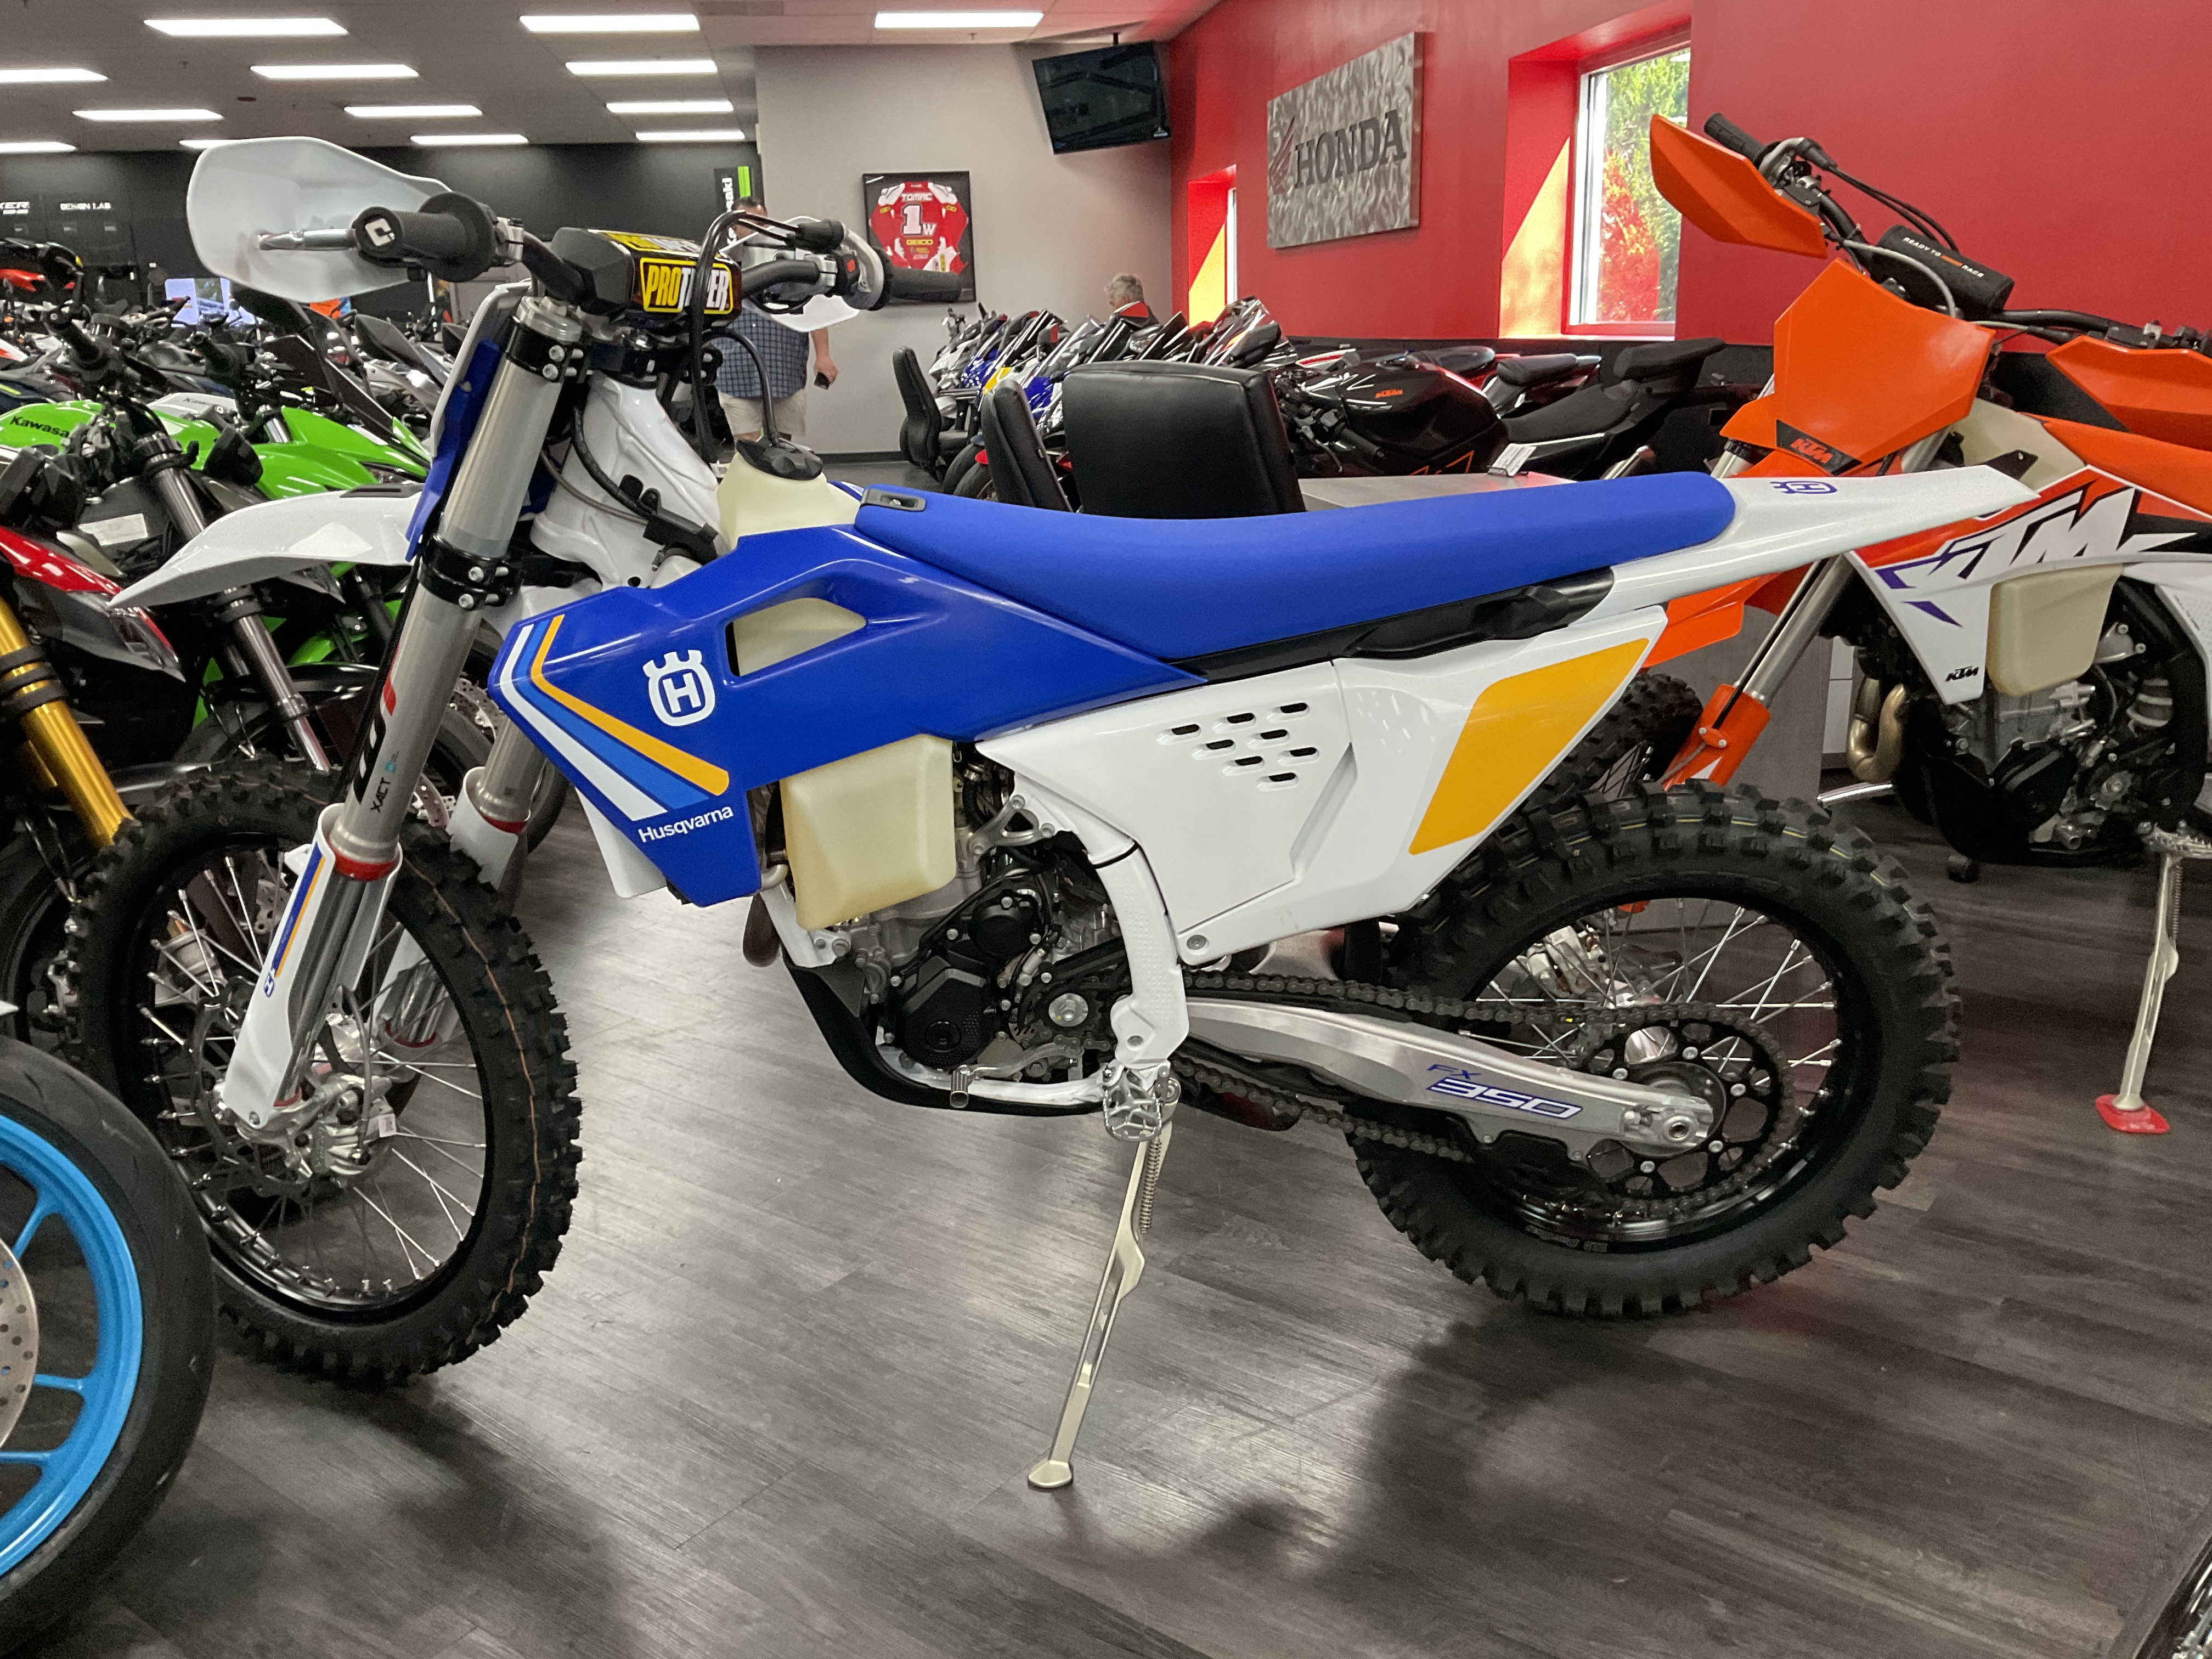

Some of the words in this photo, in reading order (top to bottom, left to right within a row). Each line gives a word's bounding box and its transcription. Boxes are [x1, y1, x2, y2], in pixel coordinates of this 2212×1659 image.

[1295, 109, 1407, 188] HONDA
[722, 177, 737, 245] Kasaki
[1903, 237, 1931, 251] READY
[1961, 264, 1984, 278] RACE
[645, 264, 729, 311] PROTER
[1791, 438, 1833, 464] KTM
[1945, 665, 1979, 682] KTM
[638, 806, 734, 843] Husqvarna
[1427, 1064, 1481, 1080] FX
[1426, 1077, 1583, 1119] 350
